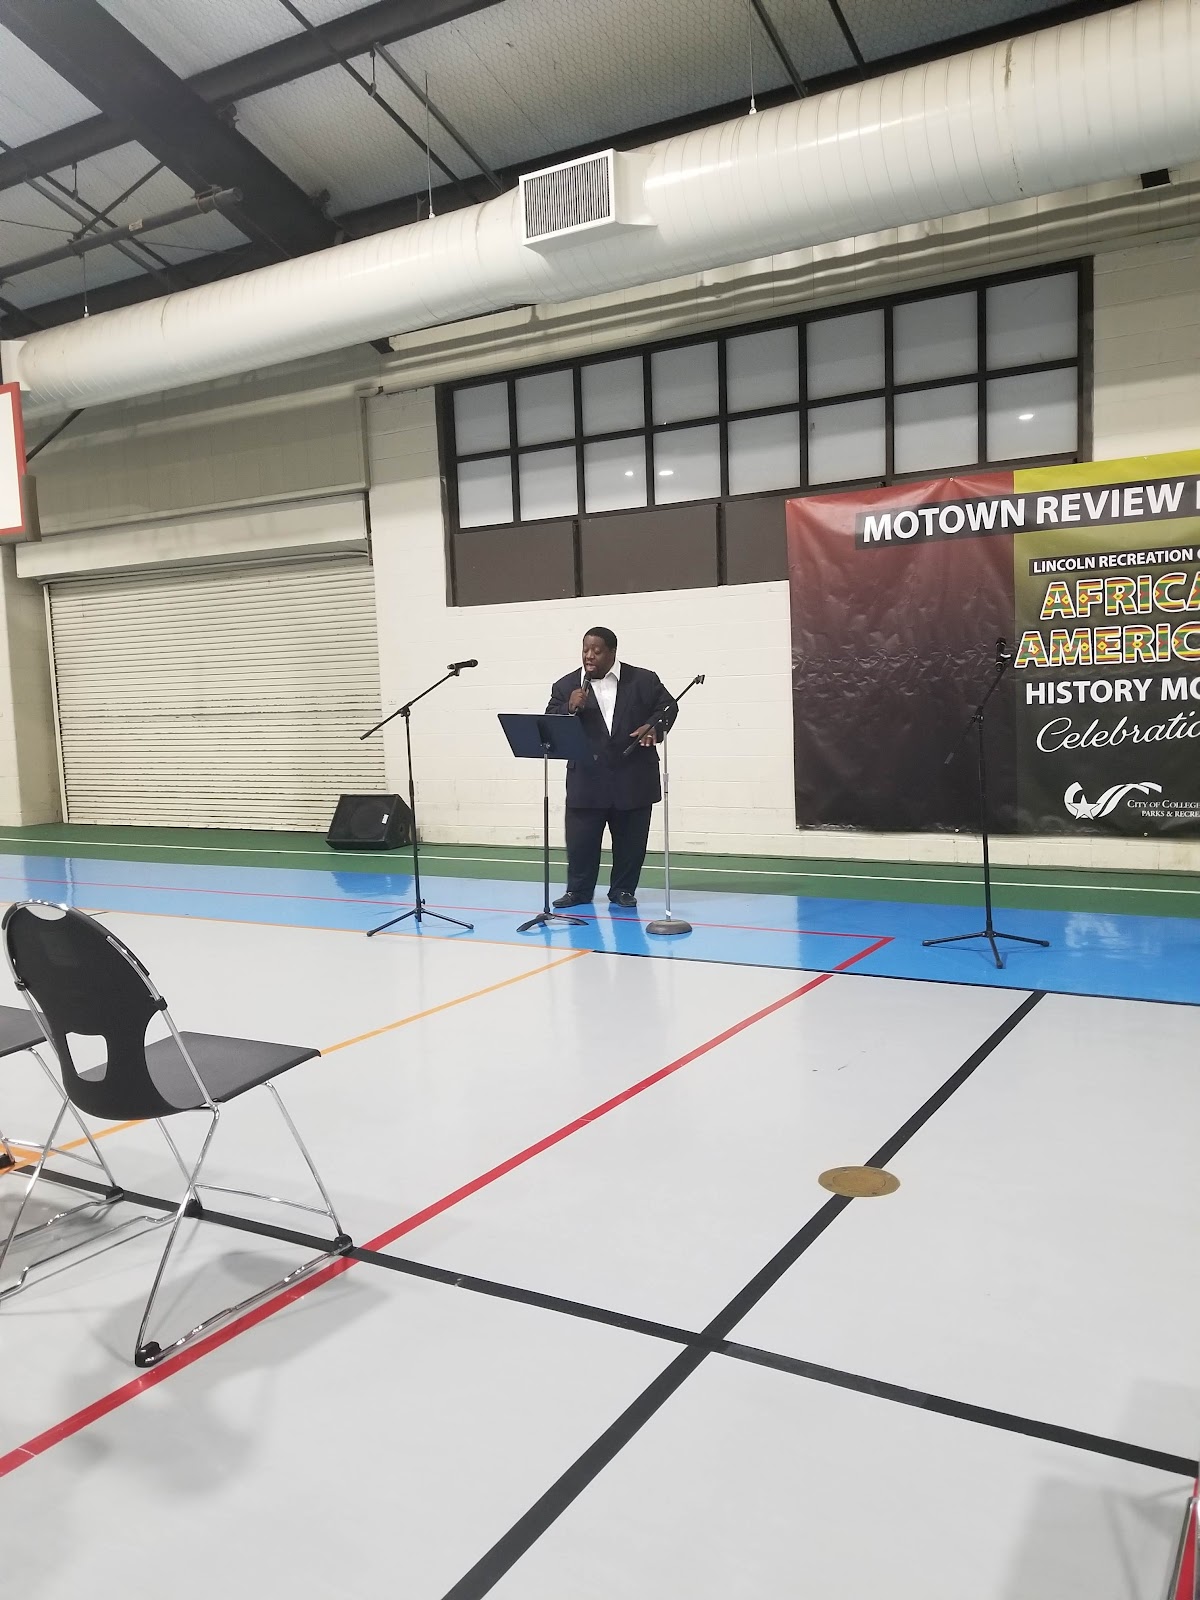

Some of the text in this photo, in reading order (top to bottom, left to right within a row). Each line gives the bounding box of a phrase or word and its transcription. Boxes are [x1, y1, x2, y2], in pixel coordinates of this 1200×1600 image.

[863, 498, 1025, 543] MOTOWN
[1036, 482, 1185, 525] REVIEW
[1033, 556, 1096, 573] LINCOLN
[1098, 548, 1193, 568] RECREATION
[1026, 678, 1152, 704] HISTORY
